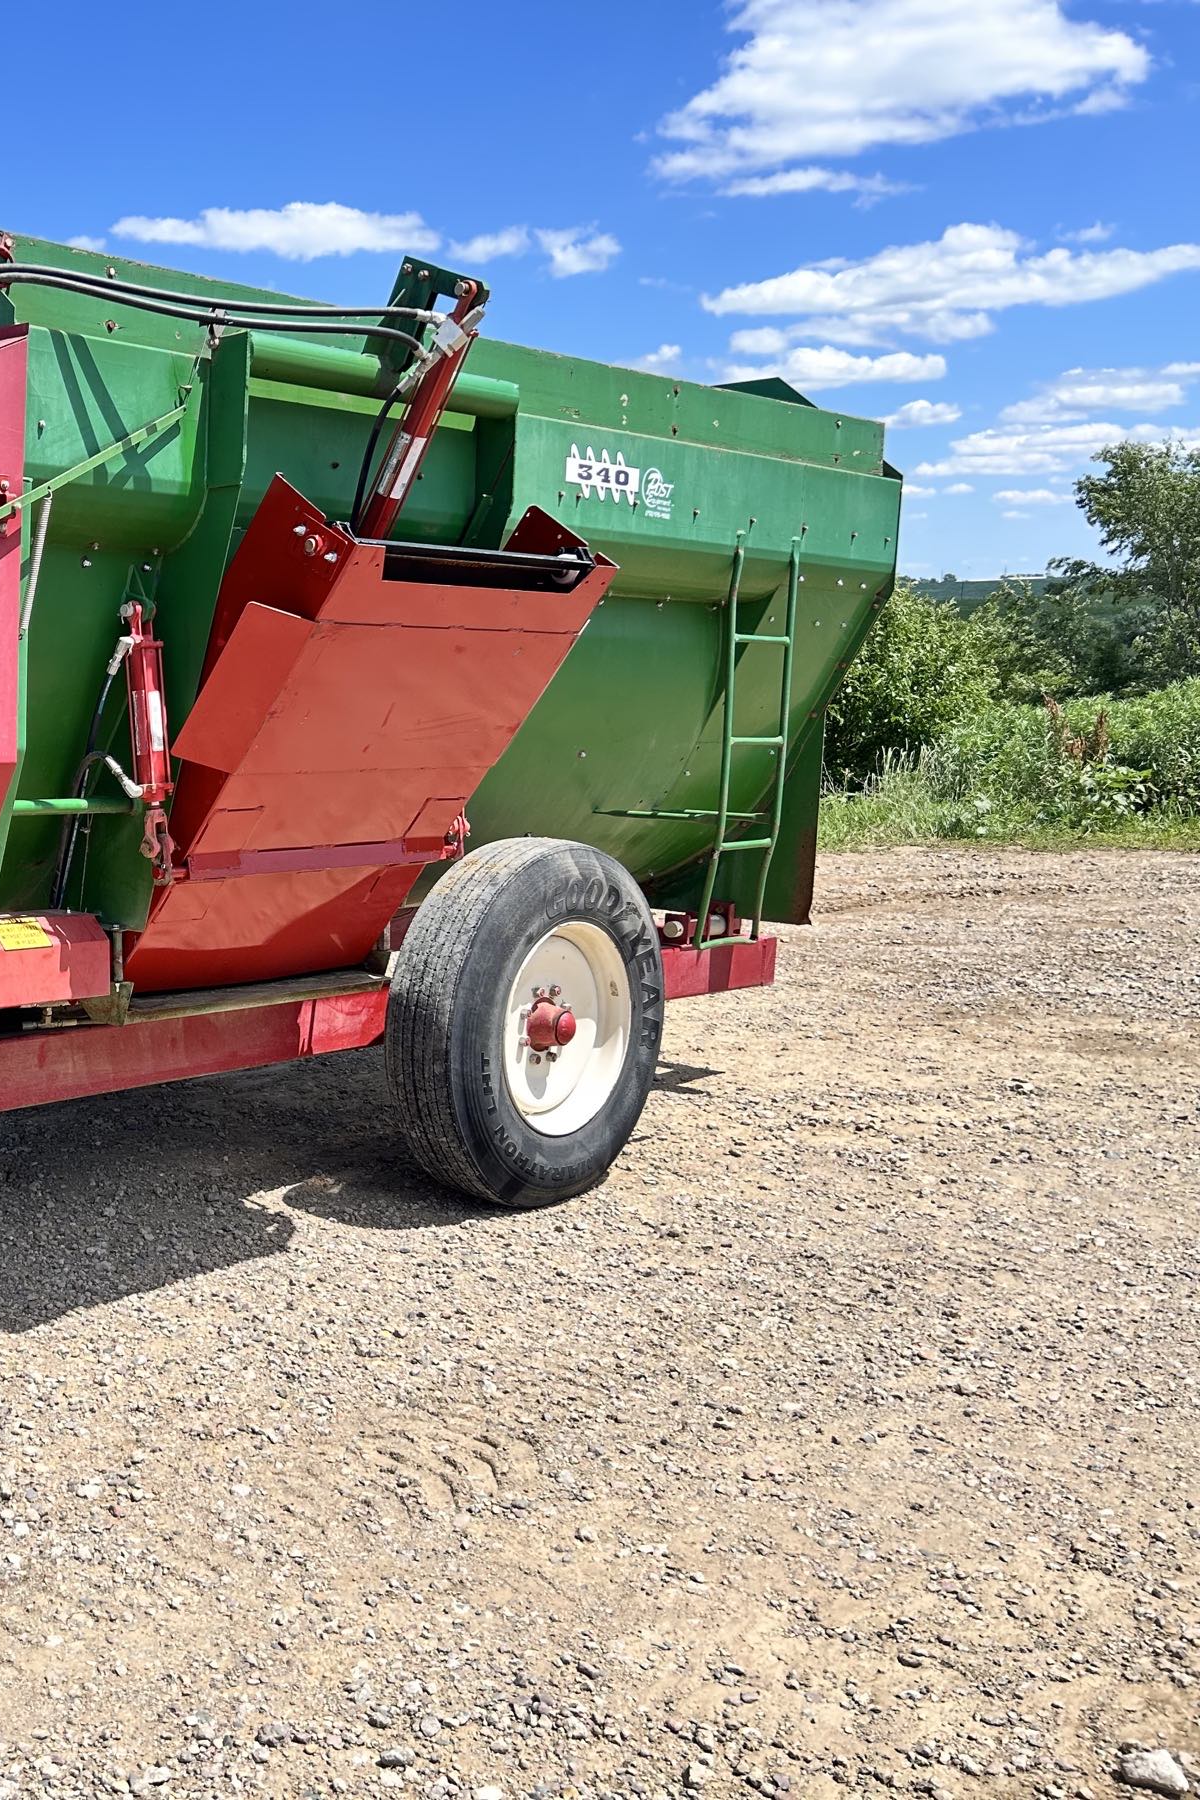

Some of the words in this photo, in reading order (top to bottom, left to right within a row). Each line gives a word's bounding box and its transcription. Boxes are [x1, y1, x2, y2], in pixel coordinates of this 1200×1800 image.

[577, 463, 630, 486] 340
[545, 877, 660, 1050] GOODYEAR
[494, 1123, 595, 1183] MARATHON
